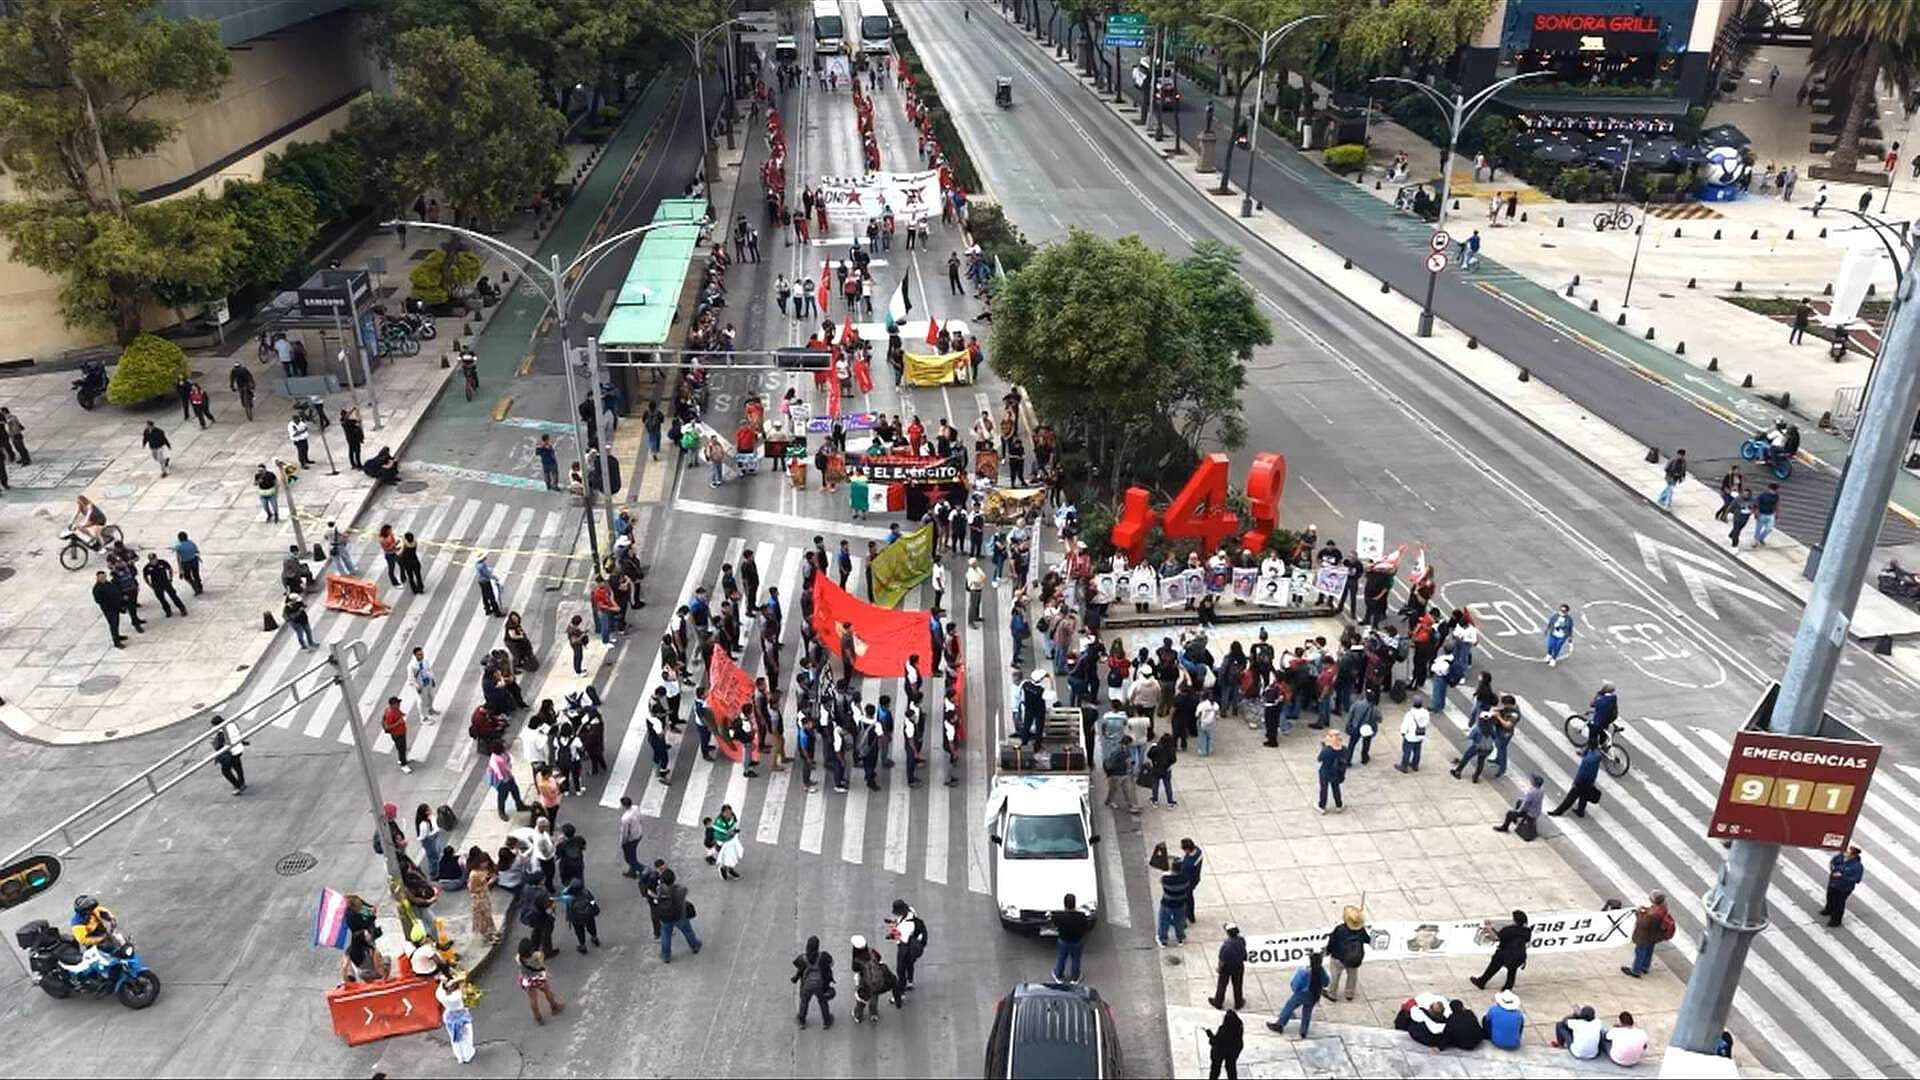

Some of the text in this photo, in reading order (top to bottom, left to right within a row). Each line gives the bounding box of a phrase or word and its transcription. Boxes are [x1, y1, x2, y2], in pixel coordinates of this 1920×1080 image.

[1535, 14, 1660, 33] SONORA GRILL
[1742, 747, 1868, 769] EMERGENCIAS
